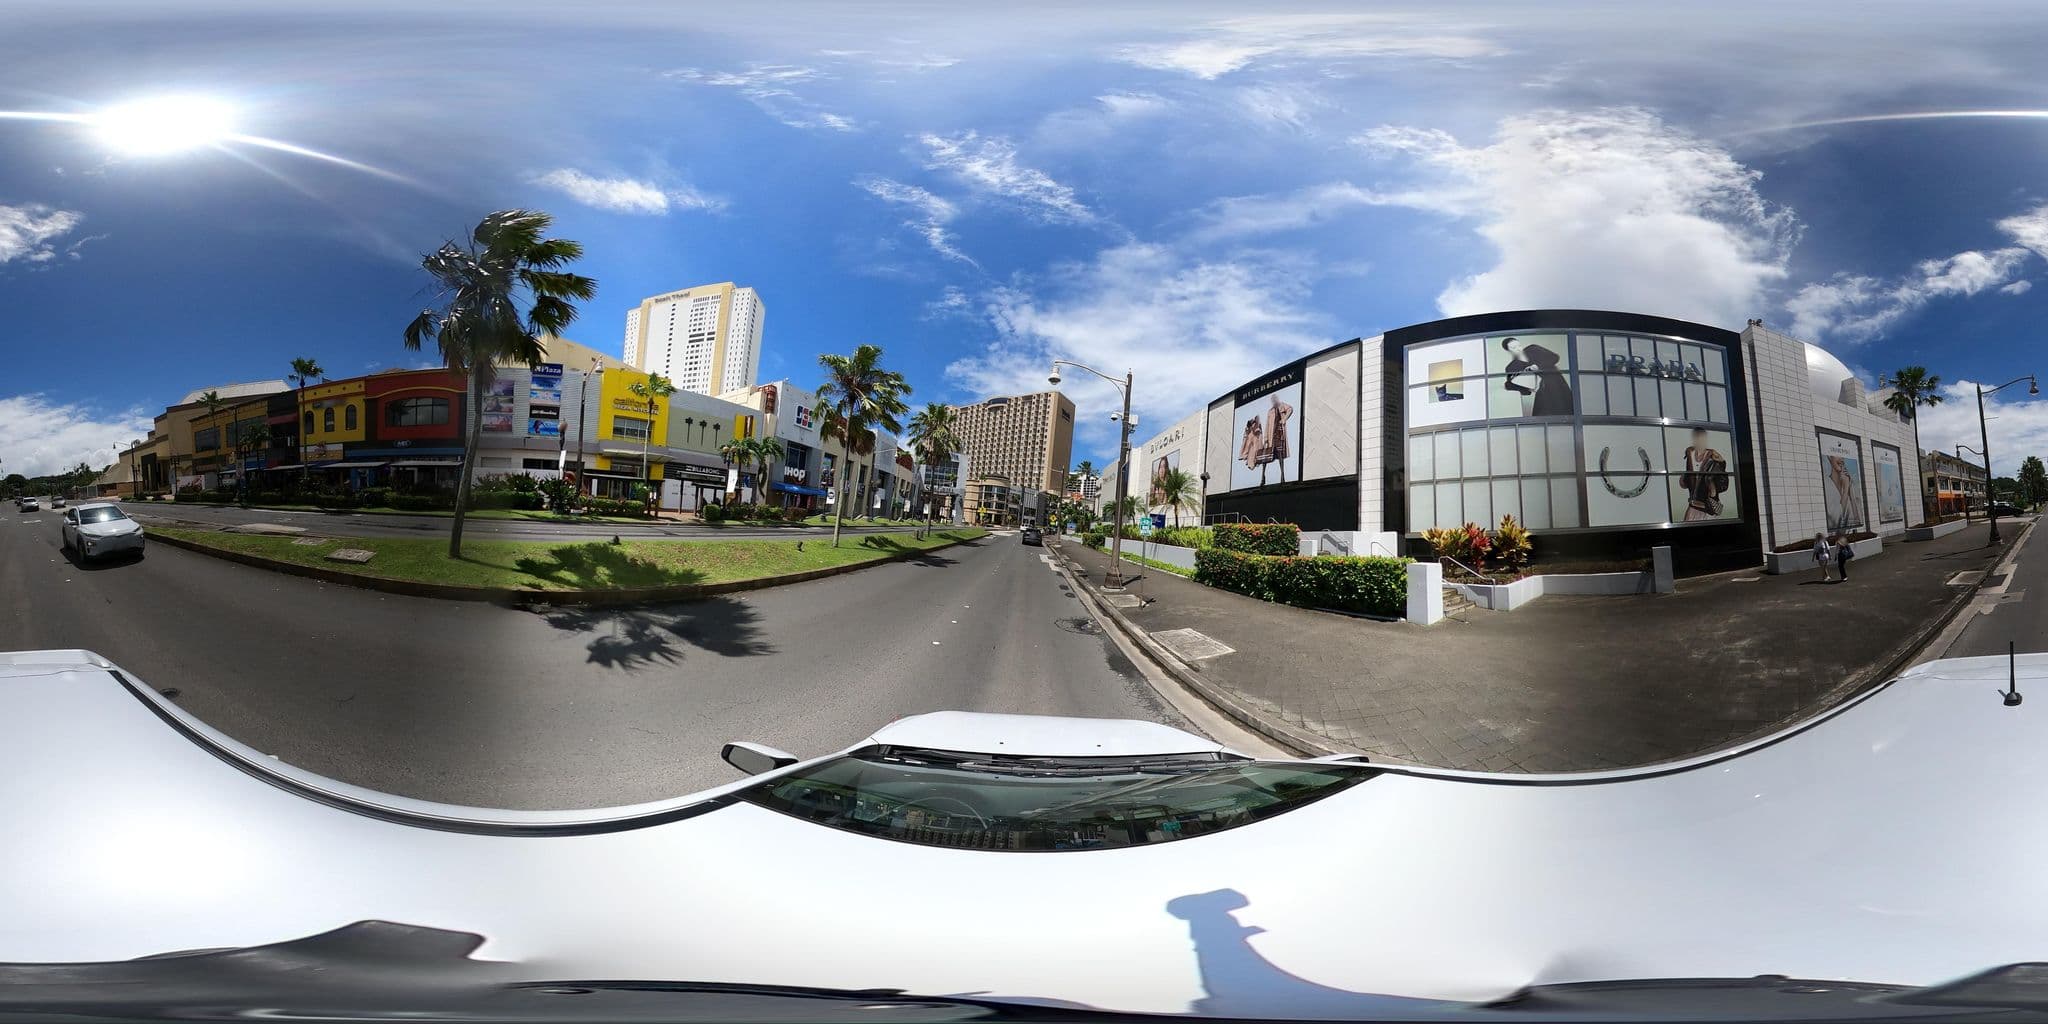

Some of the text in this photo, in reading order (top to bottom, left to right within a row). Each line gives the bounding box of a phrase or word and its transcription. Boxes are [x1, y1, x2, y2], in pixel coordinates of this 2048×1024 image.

[1607, 354, 1702, 380] PRADA
[1242, 371, 1296, 400] BURBERRY
[613, 398, 659, 410] californa
[692, 465, 720, 475] BILLABONG
